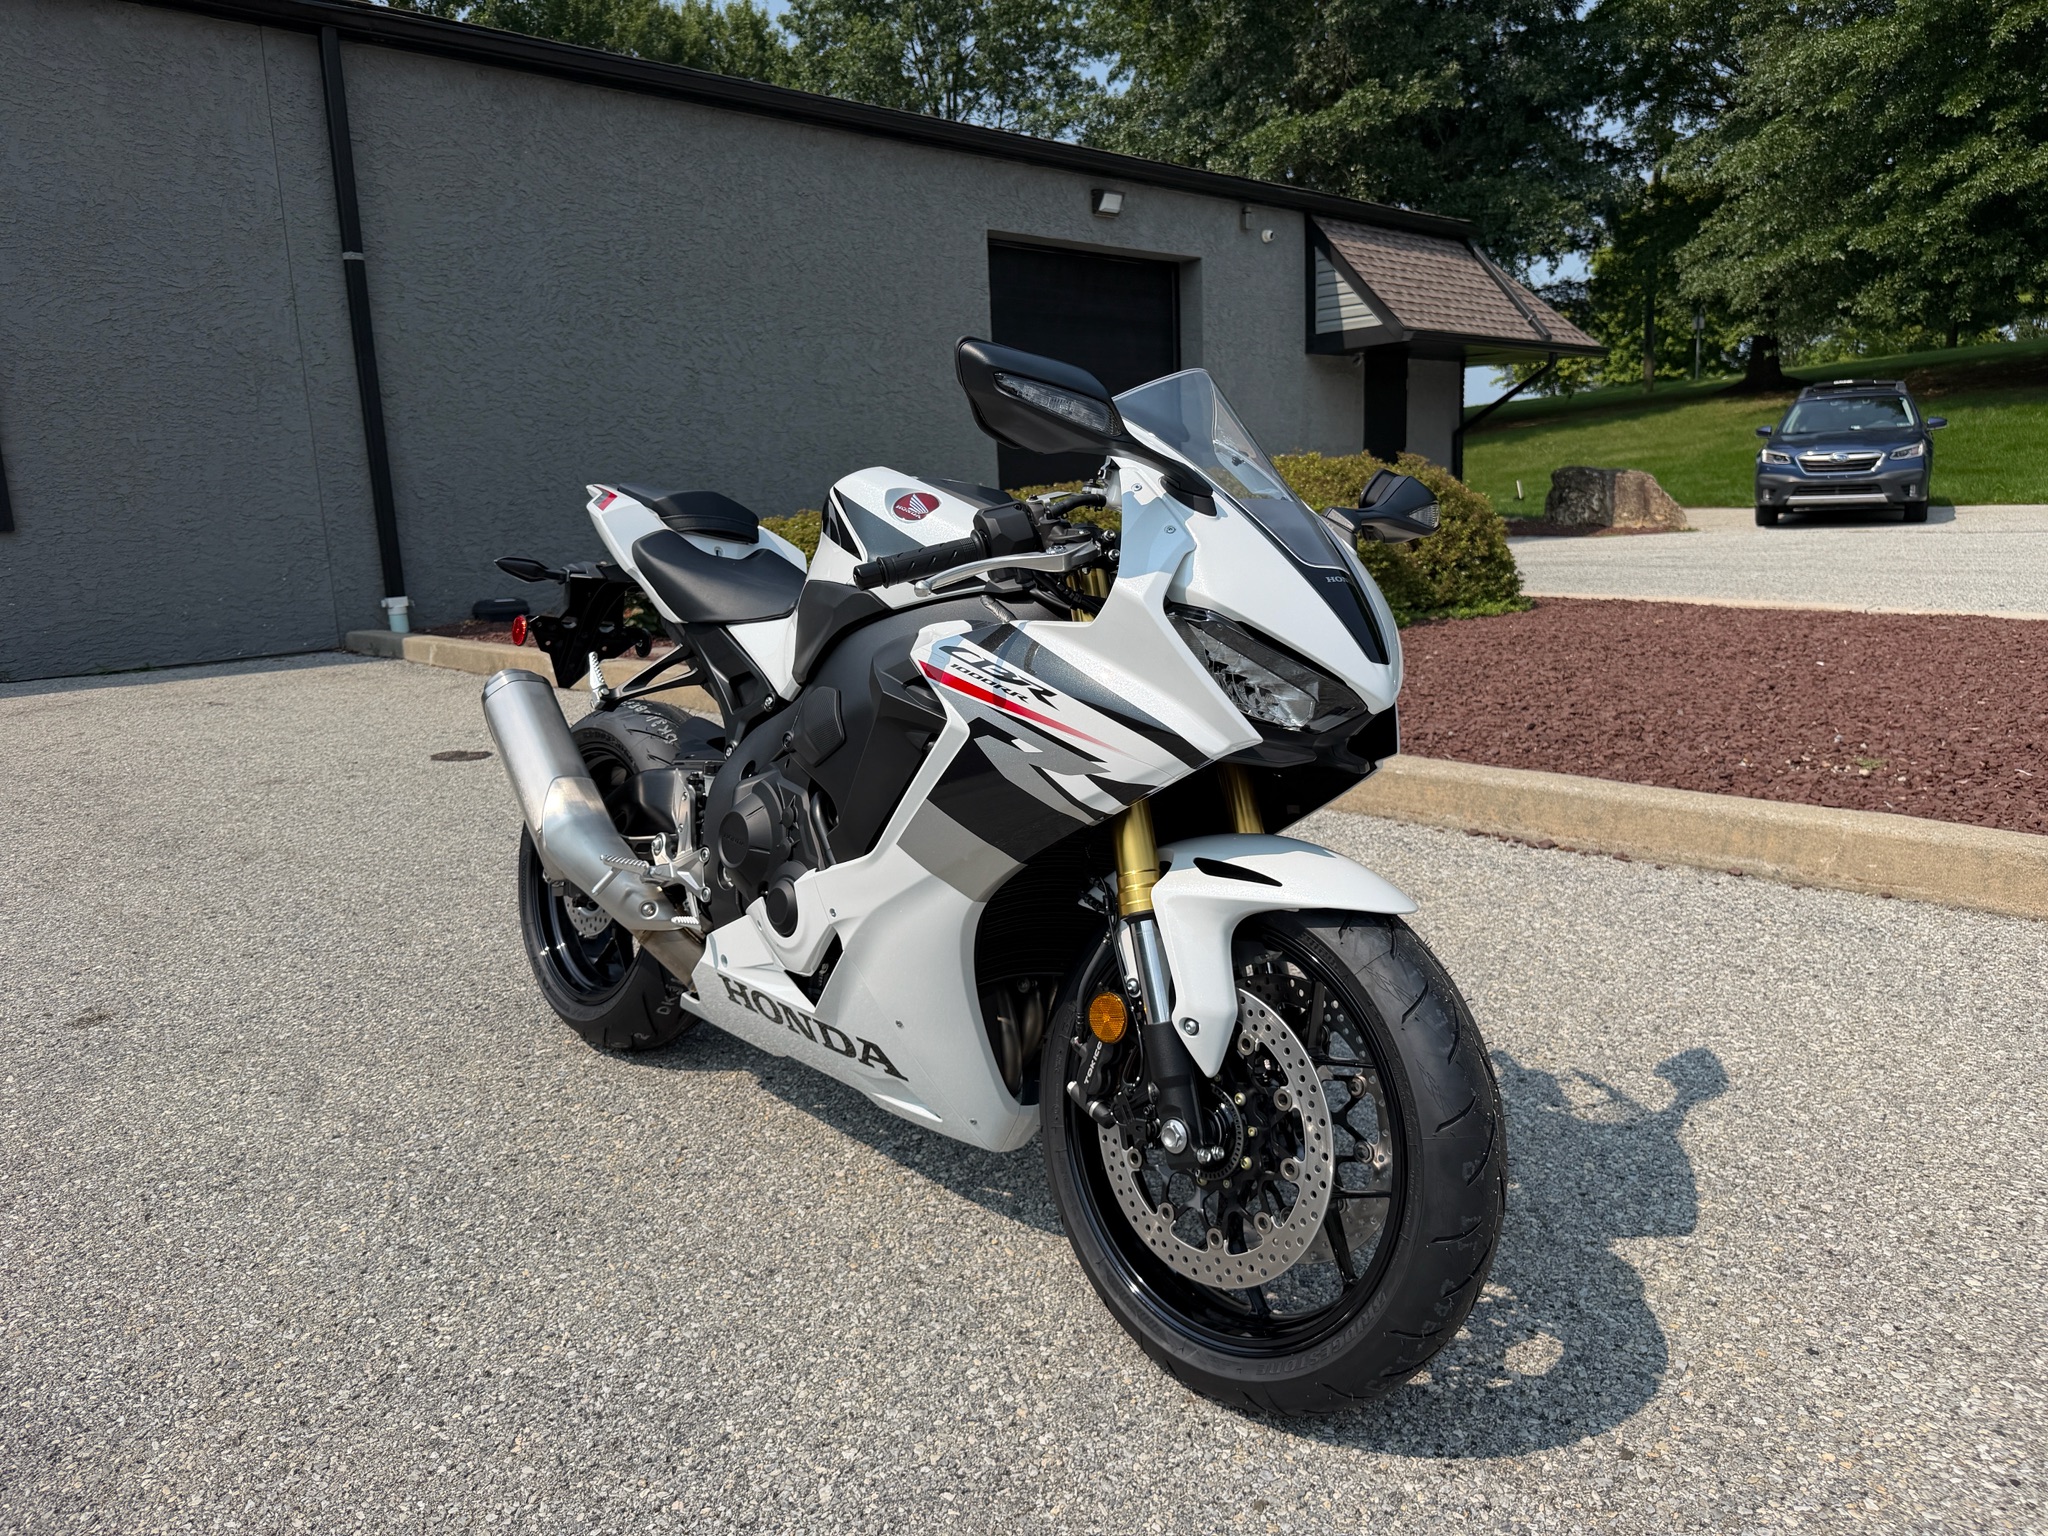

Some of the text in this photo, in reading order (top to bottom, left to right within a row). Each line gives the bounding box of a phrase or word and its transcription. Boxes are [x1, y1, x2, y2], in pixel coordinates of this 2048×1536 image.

[938, 645, 1060, 712] CBR
[950, 663, 1030, 704] 1000RR
[717, 972, 909, 1082] HONDA
[1083, 1040, 1103, 1084] TOKICO
